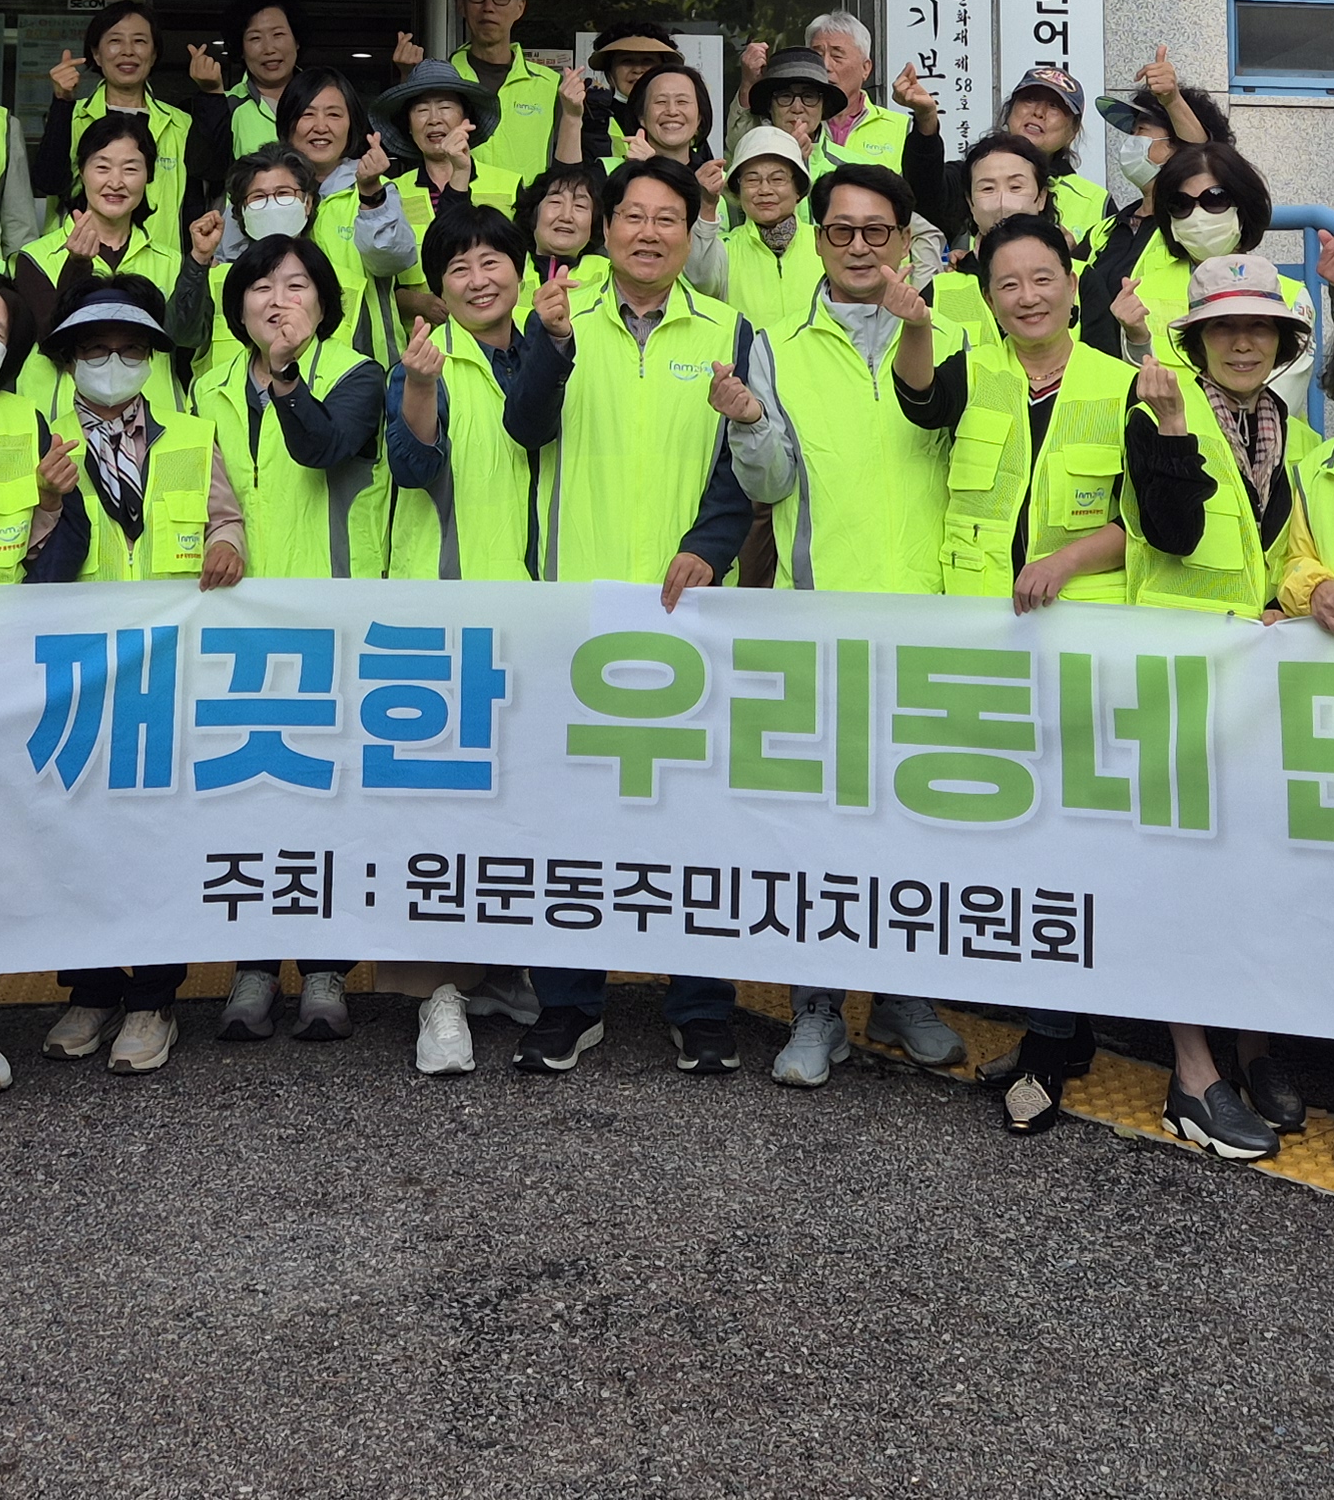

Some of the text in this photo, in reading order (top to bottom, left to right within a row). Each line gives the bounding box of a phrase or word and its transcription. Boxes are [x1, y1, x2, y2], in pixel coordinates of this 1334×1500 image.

[70, 0, 106, 9] SECOM
[24, 620, 508, 794] 깨끗한
[564, 630, 1213, 830] 우리동네
[200, 848, 1096, 970] 주최 : 원문동주민자치위원회
